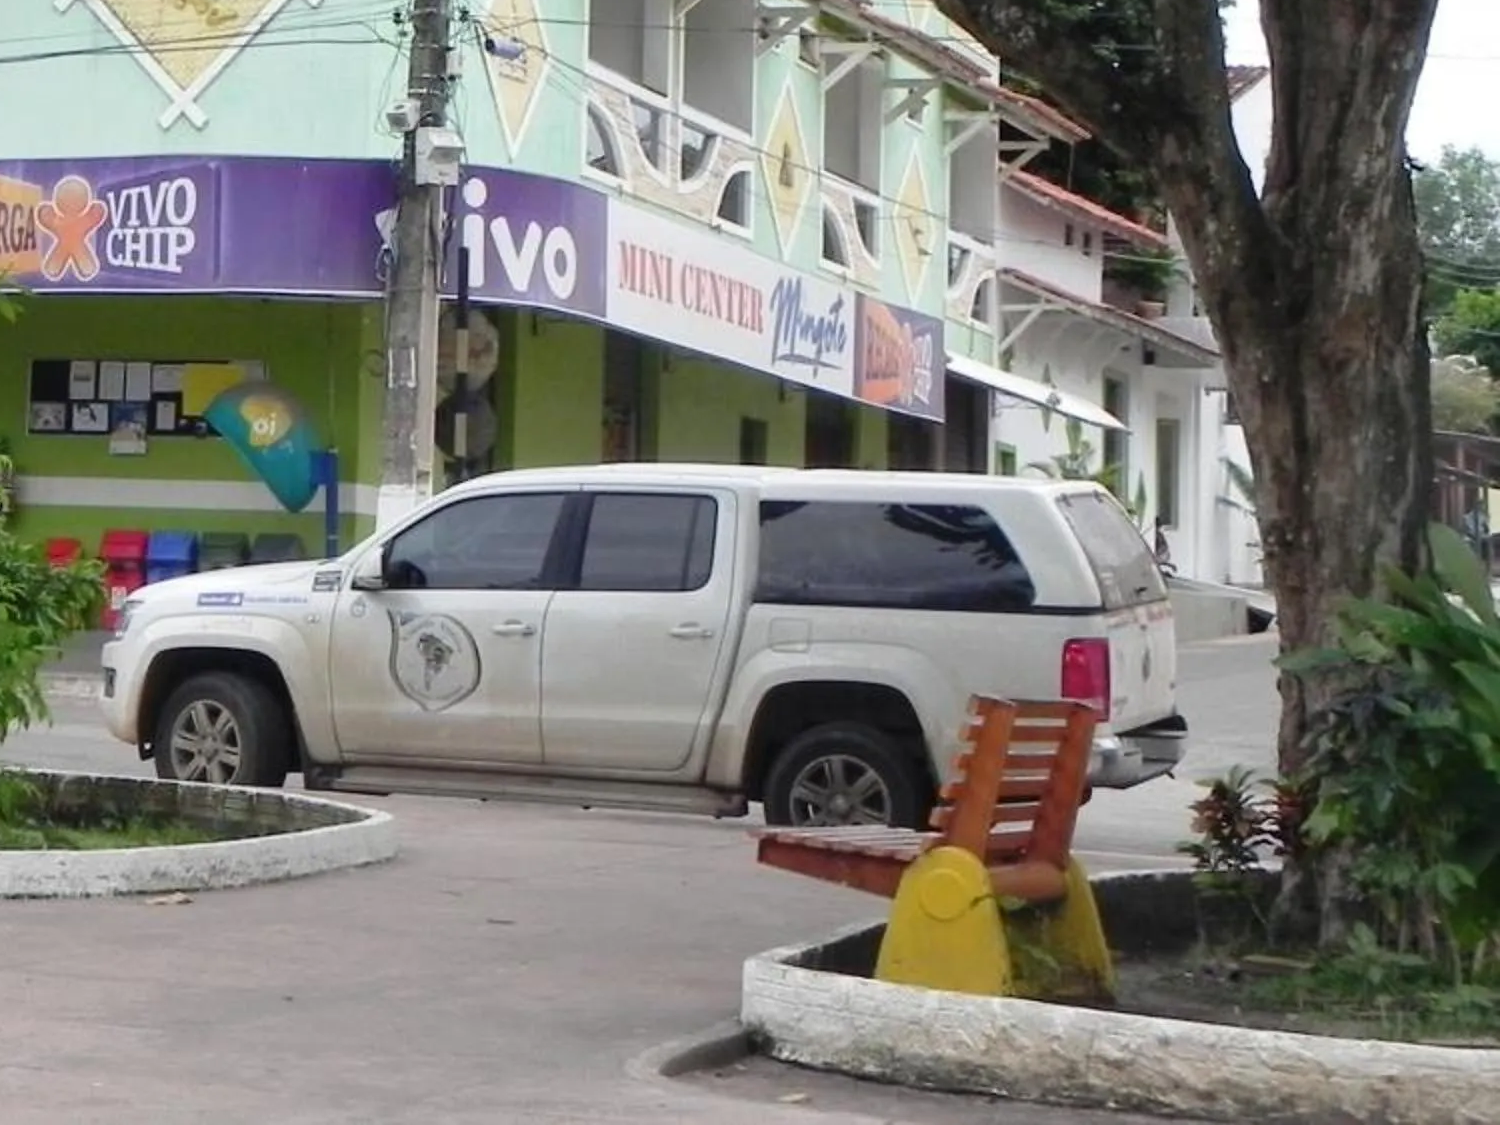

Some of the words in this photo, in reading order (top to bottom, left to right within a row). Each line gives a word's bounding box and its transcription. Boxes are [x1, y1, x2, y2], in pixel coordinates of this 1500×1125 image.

[106, 177, 197, 229] VIVO
[106, 226, 196, 274] CHIP
[618, 240, 673, 304] MINI
[680, 260, 764, 335] CENTER
